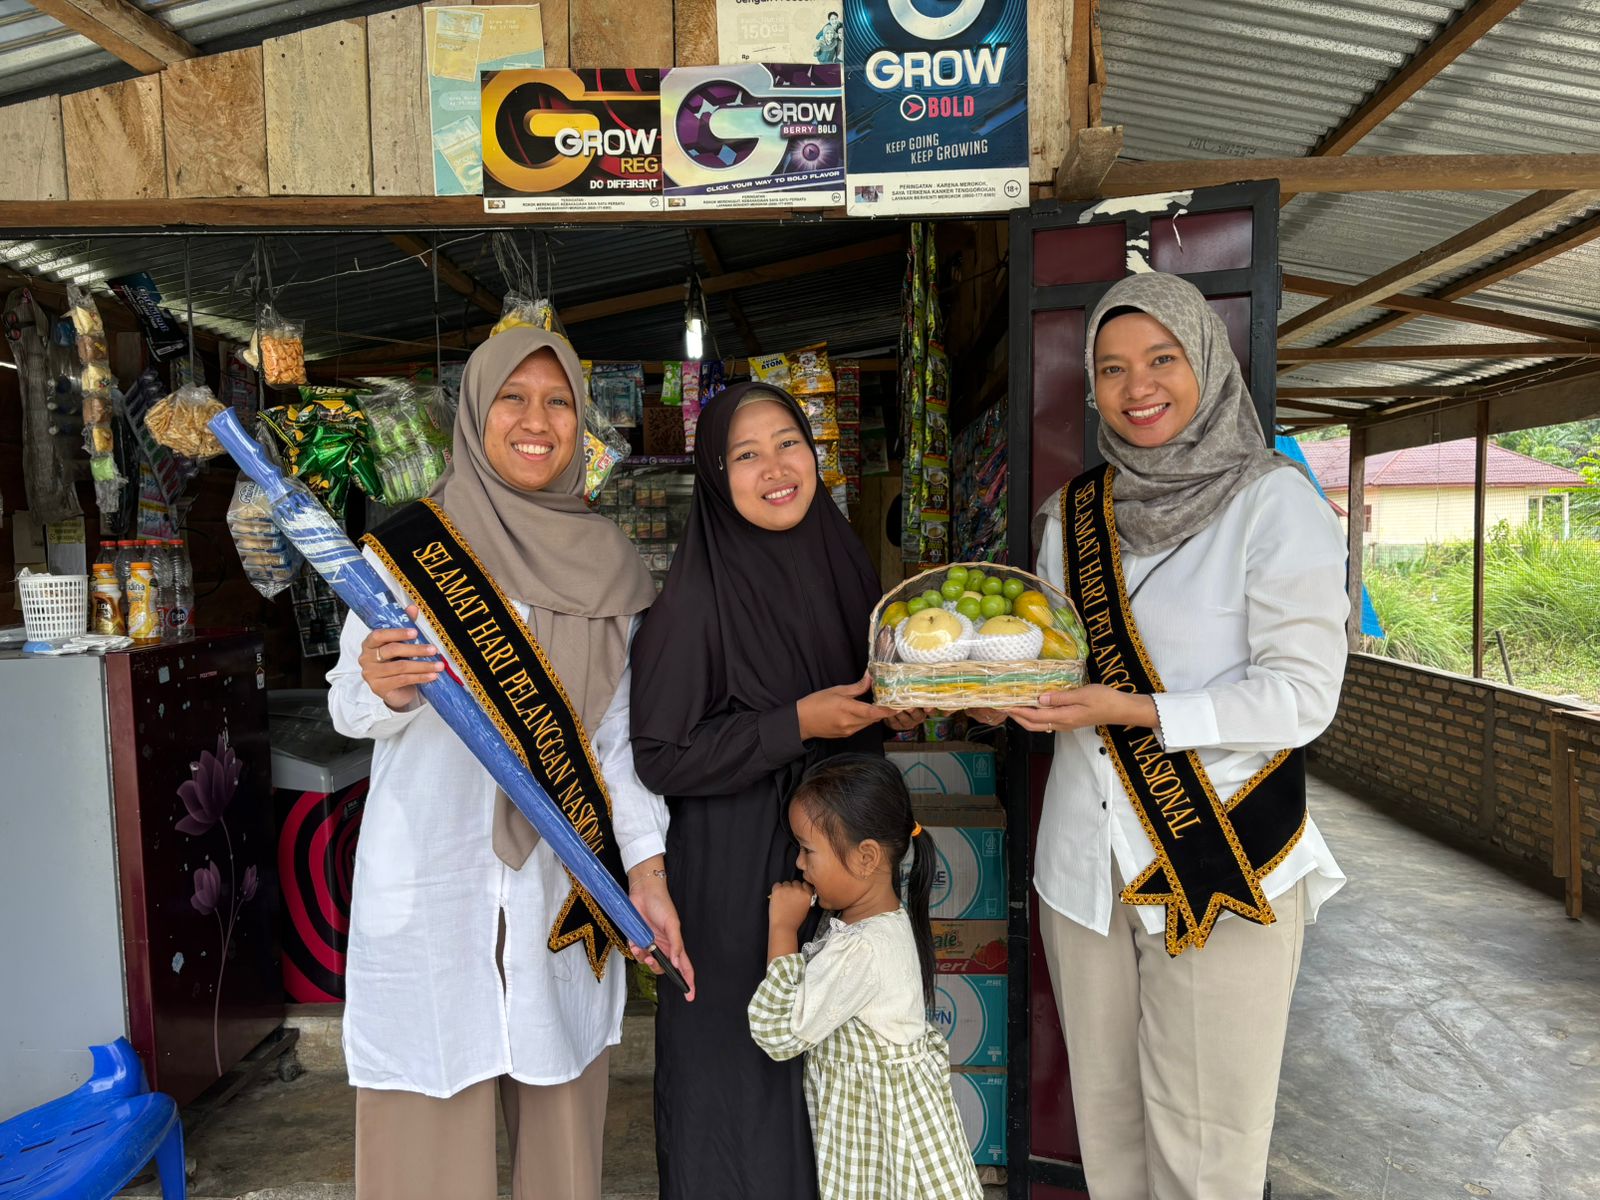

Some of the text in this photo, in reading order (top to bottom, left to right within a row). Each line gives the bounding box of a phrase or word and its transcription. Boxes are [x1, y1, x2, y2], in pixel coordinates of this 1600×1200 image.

[866, 47, 1007, 90] GROW
[762, 101, 836, 124] GROW
[928, 96, 975, 118] BOLD
[783, 125, 837, 134] BERRY BOLD
[555, 127, 657, 157] GROW
[885, 133, 939, 154] KEEP GOING
[911, 139, 988, 165] KEEP GROWING
[620, 157, 659, 173] REG
[590, 178, 658, 190] DO DIFFERENT
[706, 185, 728, 193] CLICK
[732, 181, 752, 189] YOUR
[787, 174, 808, 182] BOLD
[810, 171, 840, 180] FLAVOR
[1006, 185, 1019, 193] 18+
[761, 359, 783, 370] ATOM
[256, 652, 262, 662] 5
[412, 541, 488, 622] SELAMAT
[467, 617, 520, 675] HARI
[499, 667, 576, 786] PELANGGAN
[1074, 479, 1202, 840] SELAMAT HARI PELANG NASIONAL
